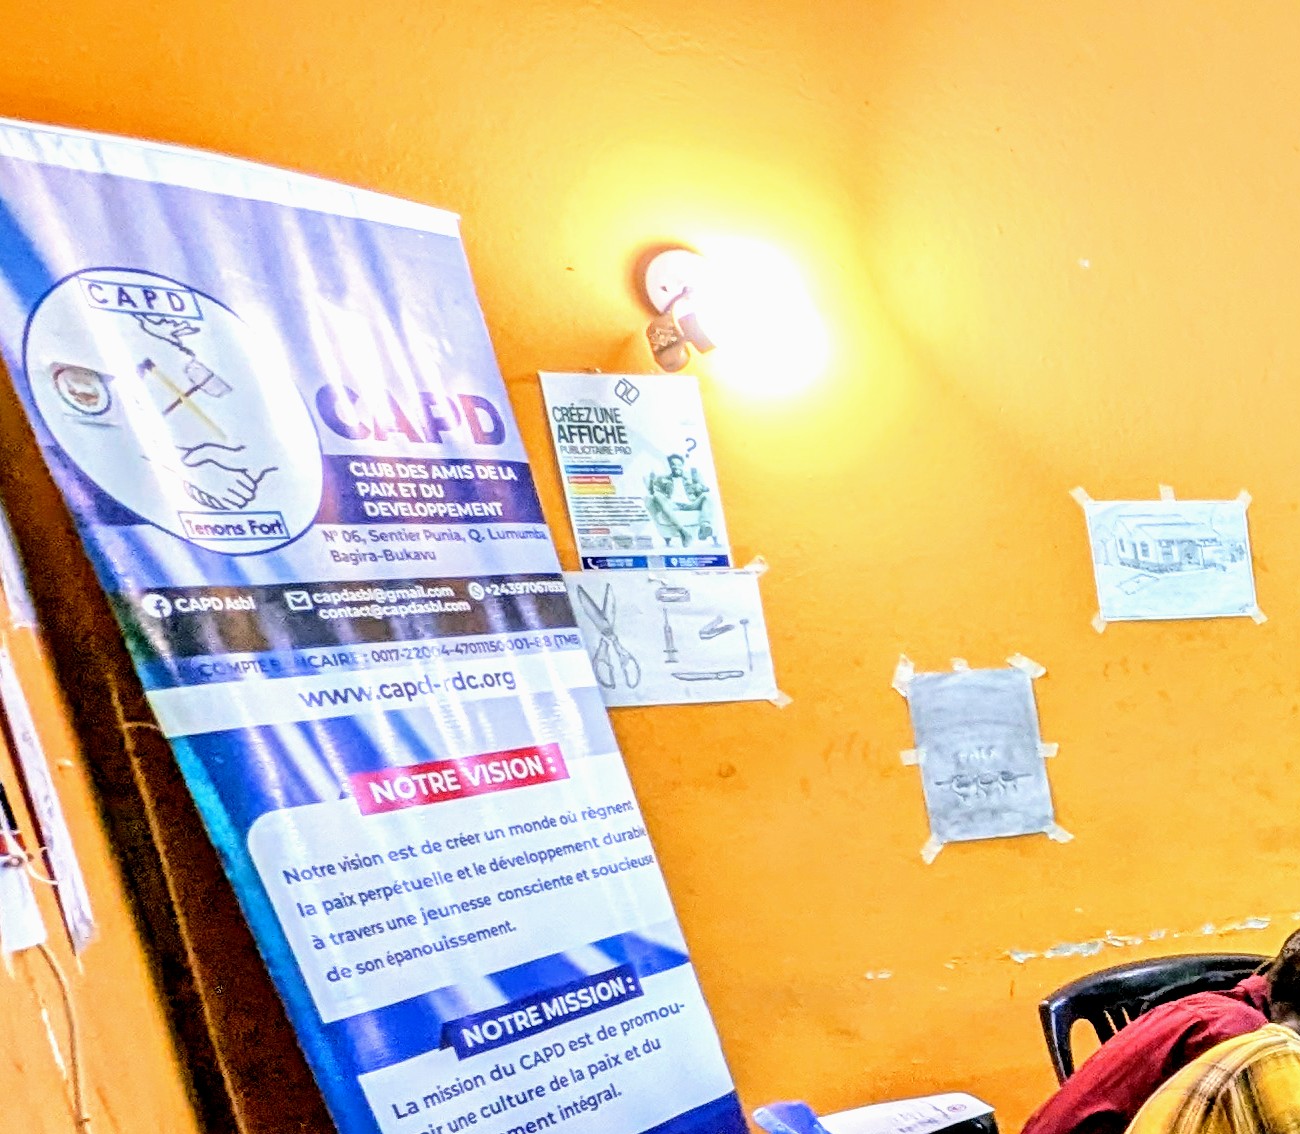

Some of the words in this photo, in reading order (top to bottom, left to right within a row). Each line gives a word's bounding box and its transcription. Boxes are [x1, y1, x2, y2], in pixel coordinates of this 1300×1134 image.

[87, 283, 186, 312] CAPD
[595, 407, 623, 424] UNE
[557, 424, 628, 445] AFFICHE
[349, 461, 396, 478] CLUB
[396, 463, 429, 479] DES
[431, 464, 475, 480] AMIS
[477, 465, 499, 480] DE
[500, 466, 518, 481] LA
[355, 481, 396, 497] PAIX
[400, 482, 417, 498] ET
[421, 483, 445, 498] DU
[363, 501, 503, 518] DEVELOPPEMENT
[185, 519, 246, 536] Tenons
[248, 519, 284, 536] Fort
[368, 529, 421, 542] Sentier
[468, 528, 485, 544] Q.
[330, 549, 437, 566] Bagira-Bukavu
[174, 597, 224, 612] CAPD
[311, 584, 455, 605] capdasbl@gmail.com
[319, 600, 472, 620] contact@capdasbl.com
[298, 670, 517, 708] www.capd-rdc.org
[368, 769, 462, 804] NOTRE
[462, 755, 545, 787] VISION
[282, 863, 336, 885] Notre
[337, 852, 385, 873] vision
[388, 845, 418, 861] est
[421, 839, 442, 855] de
[446, 831, 481, 850] créer
[485, 828, 506, 842] un
[508, 815, 558, 837] monde
[559, 810, 578, 826] où
[581, 800, 634, 821] règnent
[297, 901, 317, 918] la
[321, 892, 357, 915] paix
[358, 870, 453, 906] perpétuelle
[457, 865, 473, 881] et
[473, 861, 488, 877] le
[489, 836, 601, 873] développement
[312, 934, 327, 950] à
[329, 920, 385, 946] travers
[386, 913, 418, 932] une
[421, 894, 492, 926] jeunesse
[497, 874, 574, 902] consciente
[575, 868, 590, 883] et
[326, 965, 353, 982] de
[356, 957, 386, 976] son
[386, 920, 517, 968] épanouissement.
[461, 1005, 544, 1049] NOTRE
[542, 978, 627, 1022] MISSION
[391, 1099, 420, 1120] La
[422, 1073, 487, 1108] mission
[489, 1063, 516, 1083] du
[519, 1042, 566, 1071] CAPD
[568, 1034, 594, 1052] est
[596, 1024, 618, 1042] de
[620, 1003, 686, 1037] promou-
[448, 1112, 478, 1134] une
[480, 1084, 546, 1119] culture
[549, 1074, 569, 1092] de
[570, 1067, 586, 1083] la
[587, 1052, 623, 1079] paix
[625, 1046, 641, 1062] et
[643, 1036, 662, 1054] du
[558, 1082, 623, 1121] intégral.
